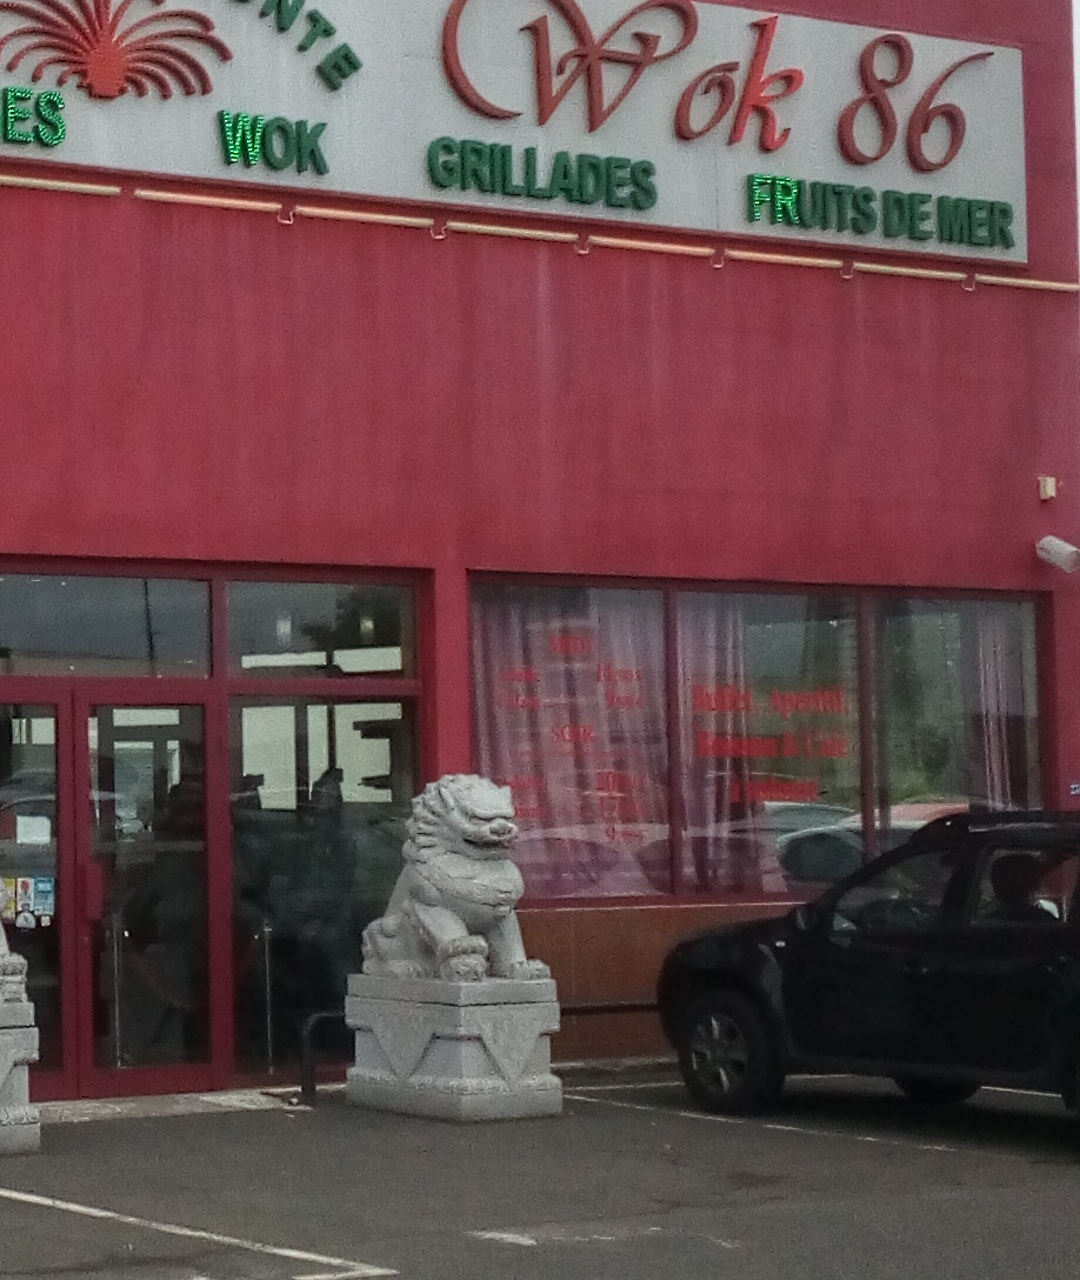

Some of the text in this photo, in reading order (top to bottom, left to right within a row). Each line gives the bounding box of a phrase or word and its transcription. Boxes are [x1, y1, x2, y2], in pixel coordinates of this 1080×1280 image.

[837, 32, 995, 172] 86
[218, 109, 330, 175] WOK
[427, 135, 658, 210] GRILLADES
[747, 172, 1016, 249] FRUITS DE MER
